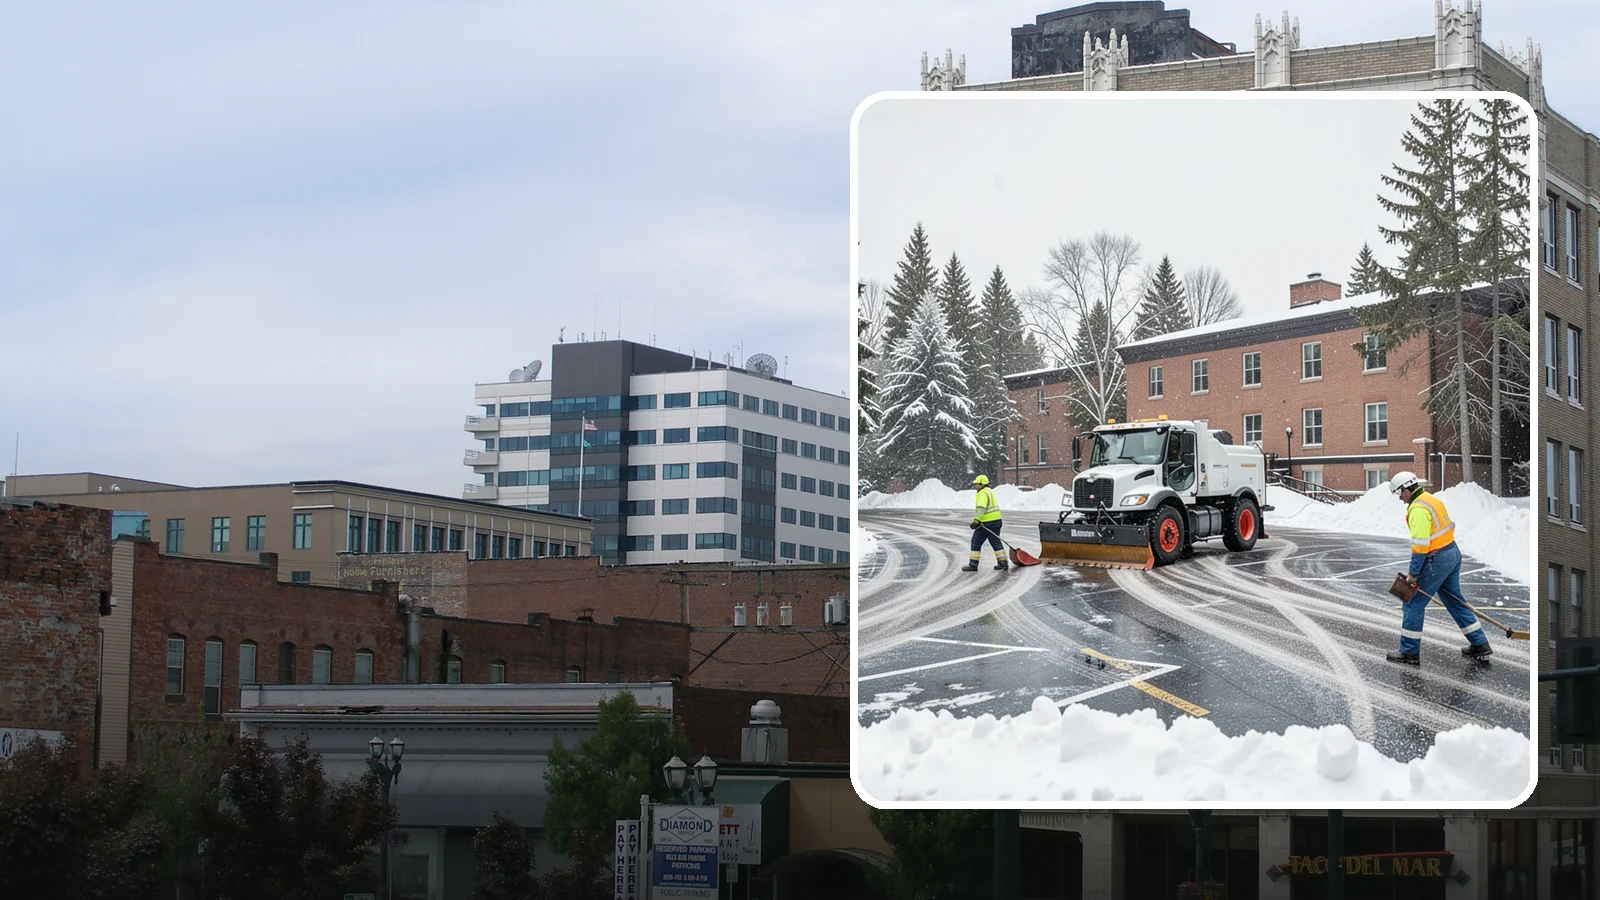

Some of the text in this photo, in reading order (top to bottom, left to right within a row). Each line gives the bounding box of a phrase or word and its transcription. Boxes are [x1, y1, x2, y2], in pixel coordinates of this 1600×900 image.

[660, 818, 713, 833] DIAMOND
[1021, 815, 1070, 828] BUILDING
[656, 845, 688, 853] RESERVED
[616, 825, 625, 894] PAY HERE
[627, 825, 636, 893] PAY HERE
[722, 852, 738, 862] Soup
[671, 862, 701, 870] PATRONS
[1288, 855, 1443, 877] TAC DEL MAR
[660, 889, 710, 898] PUBLIC PARKING
